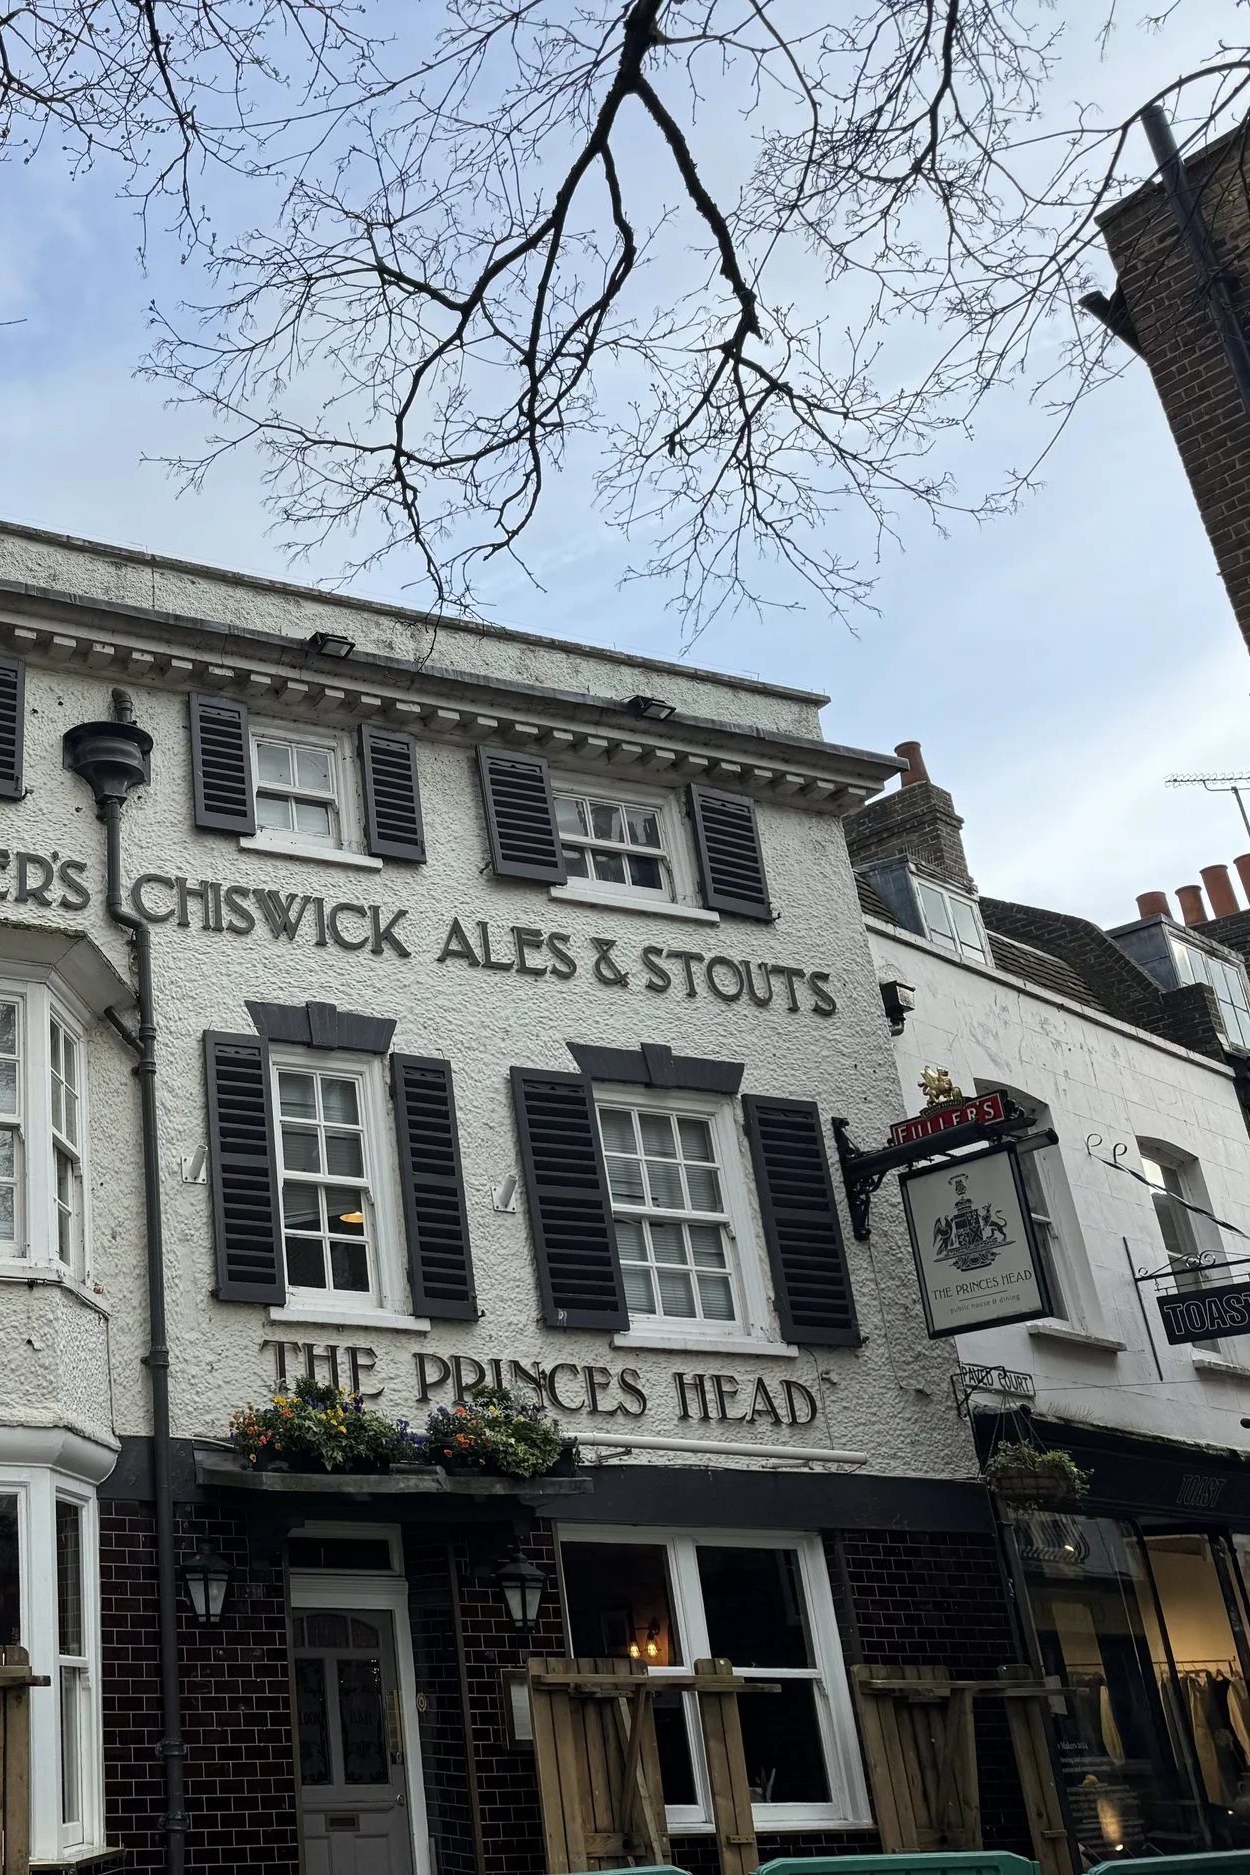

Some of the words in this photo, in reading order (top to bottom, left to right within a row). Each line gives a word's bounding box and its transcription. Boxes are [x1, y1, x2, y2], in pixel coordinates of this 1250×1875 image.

[130, 873, 412, 957] CHISWICK
[436, 916, 578, 979] ALES
[590, 936, 630, 987] &
[641, 945, 838, 1016] STOUTS
[931, 1287, 953, 1300] THE
[955, 1277, 999, 1295] PRINCES
[1001, 1269, 1033, 1286] HEAD
[950, 1305, 969, 1314] public
[971, 1300, 990, 1309] house
[999, 1294, 1021, 1303] dining
[258, 1339, 386, 1398] THE
[413, 1352, 647, 1417] PRINCES
[673, 1372, 818, 1427] HEAD
[997, 1372, 1030, 1393] COURT
[1176, 1473, 1227, 1508] TOAST
